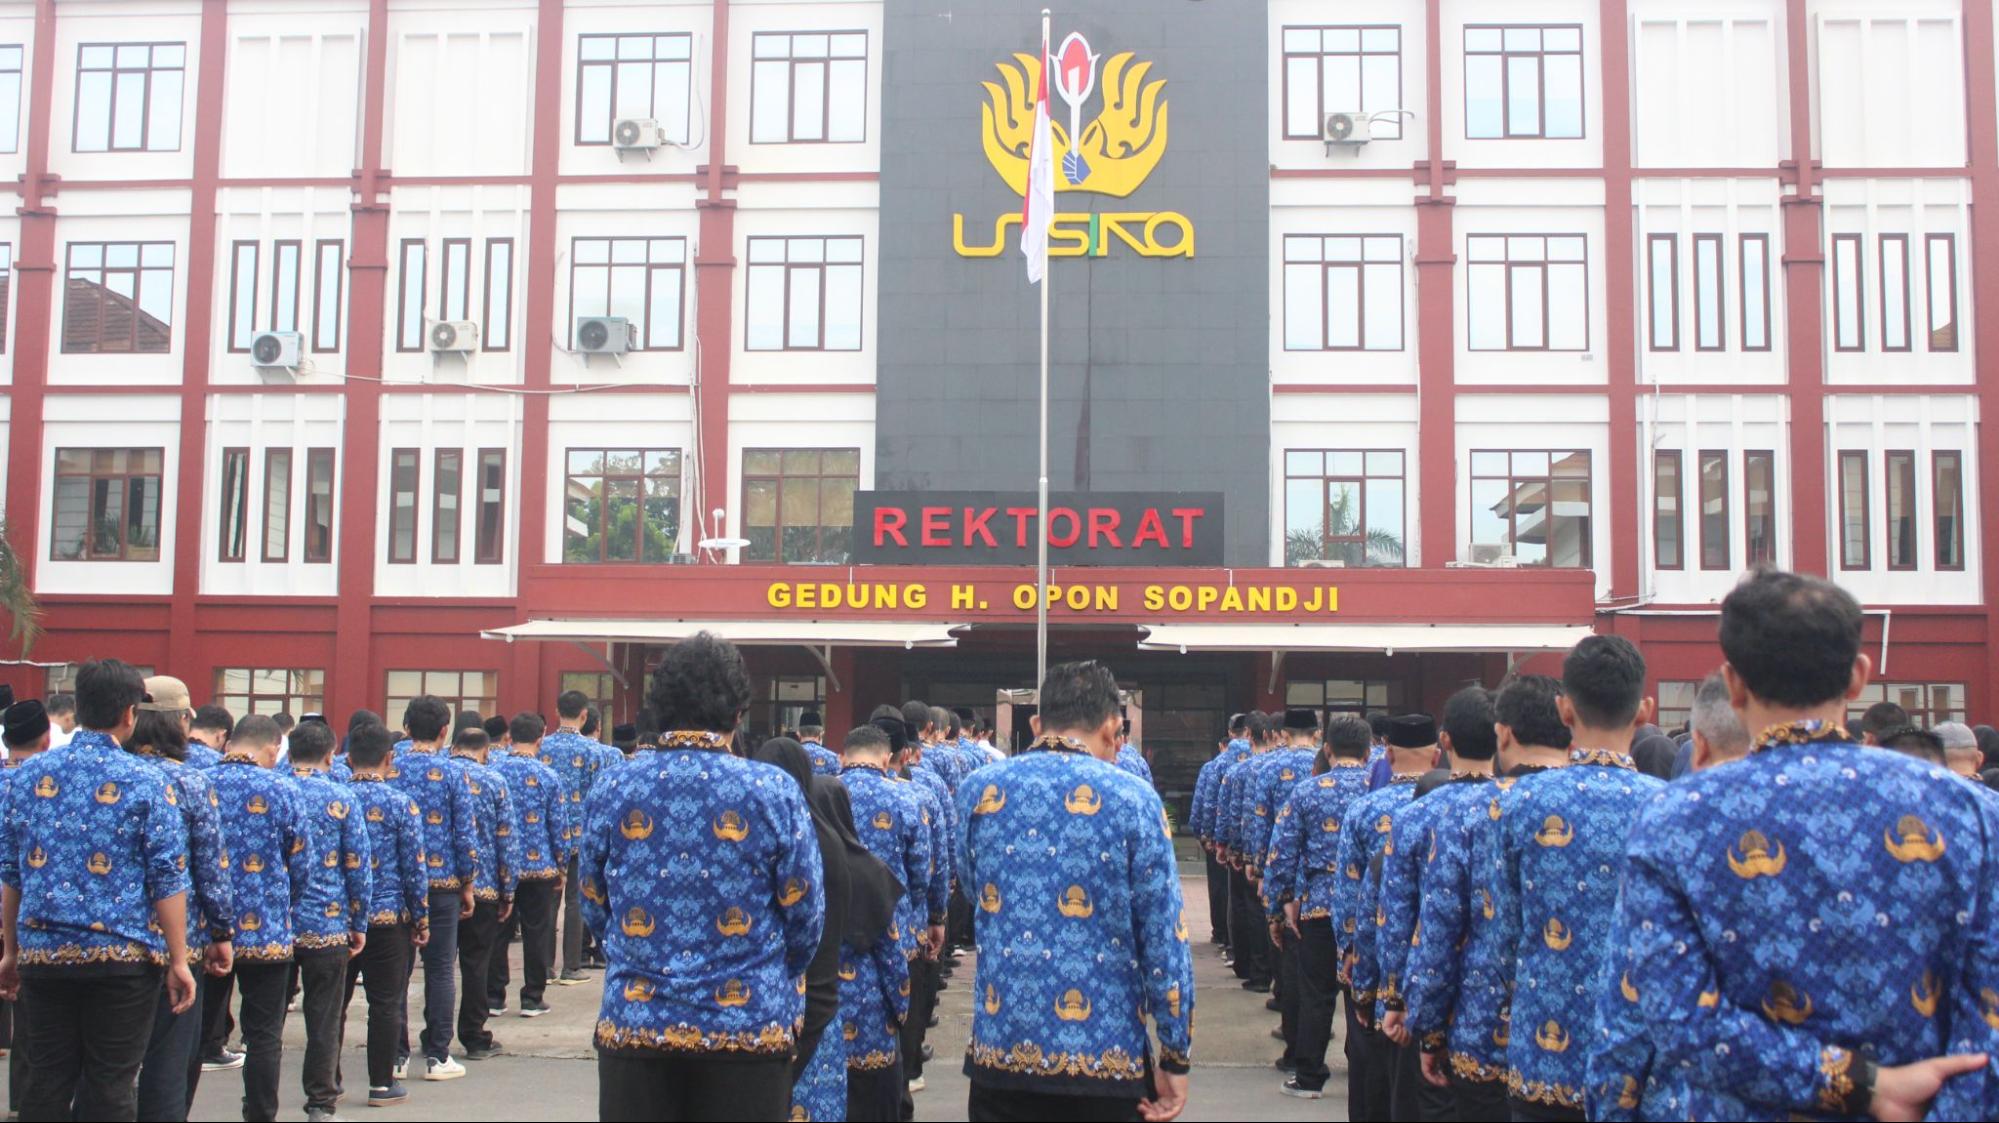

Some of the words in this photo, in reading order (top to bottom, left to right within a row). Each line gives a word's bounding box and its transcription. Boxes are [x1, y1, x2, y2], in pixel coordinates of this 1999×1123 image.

[873, 507, 1205, 549] REKTORAT
[767, 581, 928, 609] GEDUNG
[951, 584, 989, 610] H.
[1012, 584, 1119, 611] OPON
[1144, 585, 1340, 612] SOPANDJI
